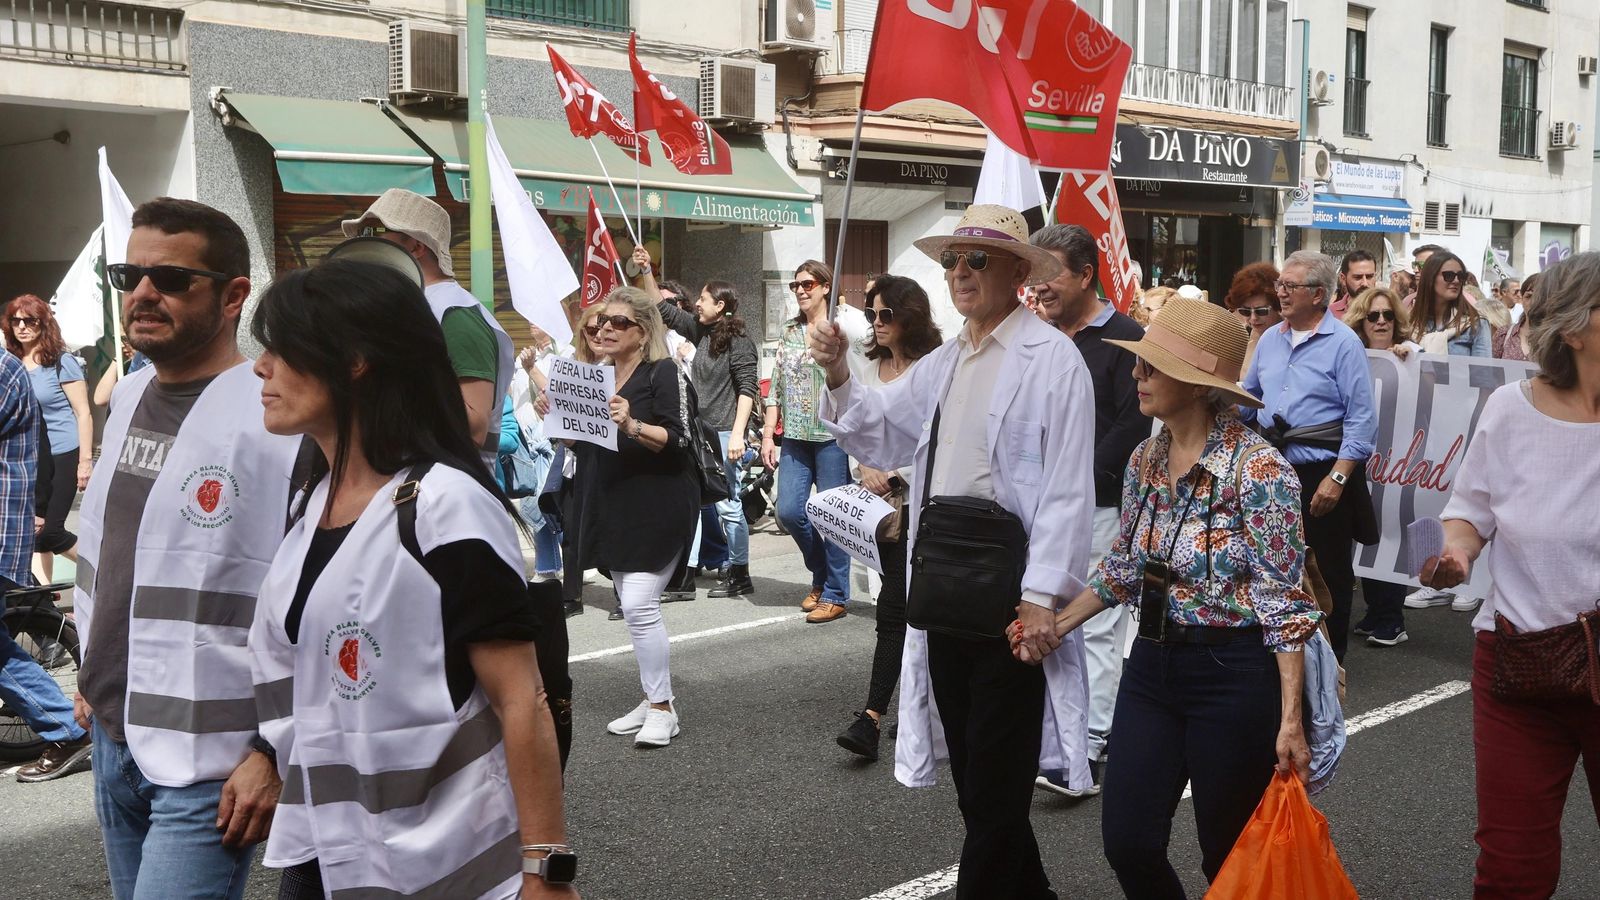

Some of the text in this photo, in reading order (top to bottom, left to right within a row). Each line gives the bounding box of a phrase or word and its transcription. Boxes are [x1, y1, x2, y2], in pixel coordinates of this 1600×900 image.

[1027, 80, 1105, 114] Sevilla
[1149, 129, 1185, 162] DA
[901, 163, 948, 180] DA PINO
[1203, 168, 1248, 183] Restaurante
[1337, 163, 1343, 175] El
[1344, 163, 1365, 177] Mundo
[1366, 165, 1374, 178] de
[1375, 166, 1384, 179] las
[1126, 179, 1139, 191] DA
[691, 195, 799, 225] Alimentación
[1338, 212, 1376, 226] Microscopios
[1379, 214, 1411, 228] Telescopios
[1097, 232, 1123, 304] Sevilla
[553, 359, 604, 383] FUERA LAS
[550, 378, 607, 403] EMPRESAS
[555, 398, 610, 421] PRIVADAS
[563, 417, 609, 439] DEL SAD
[180, 465, 240, 497] MAREA BLANCA GELVES
[823, 493, 865, 521] LISTAS DE
[858, 490, 877, 504] DE
[186, 505, 207, 521] NUESTRA
[191, 520, 201, 528] LOS
[202, 514, 233, 529] RECORTES
[807, 503, 875, 546] ESPERAS EN LA
[325, 621, 382, 658] MAREA BLAN GELVES
